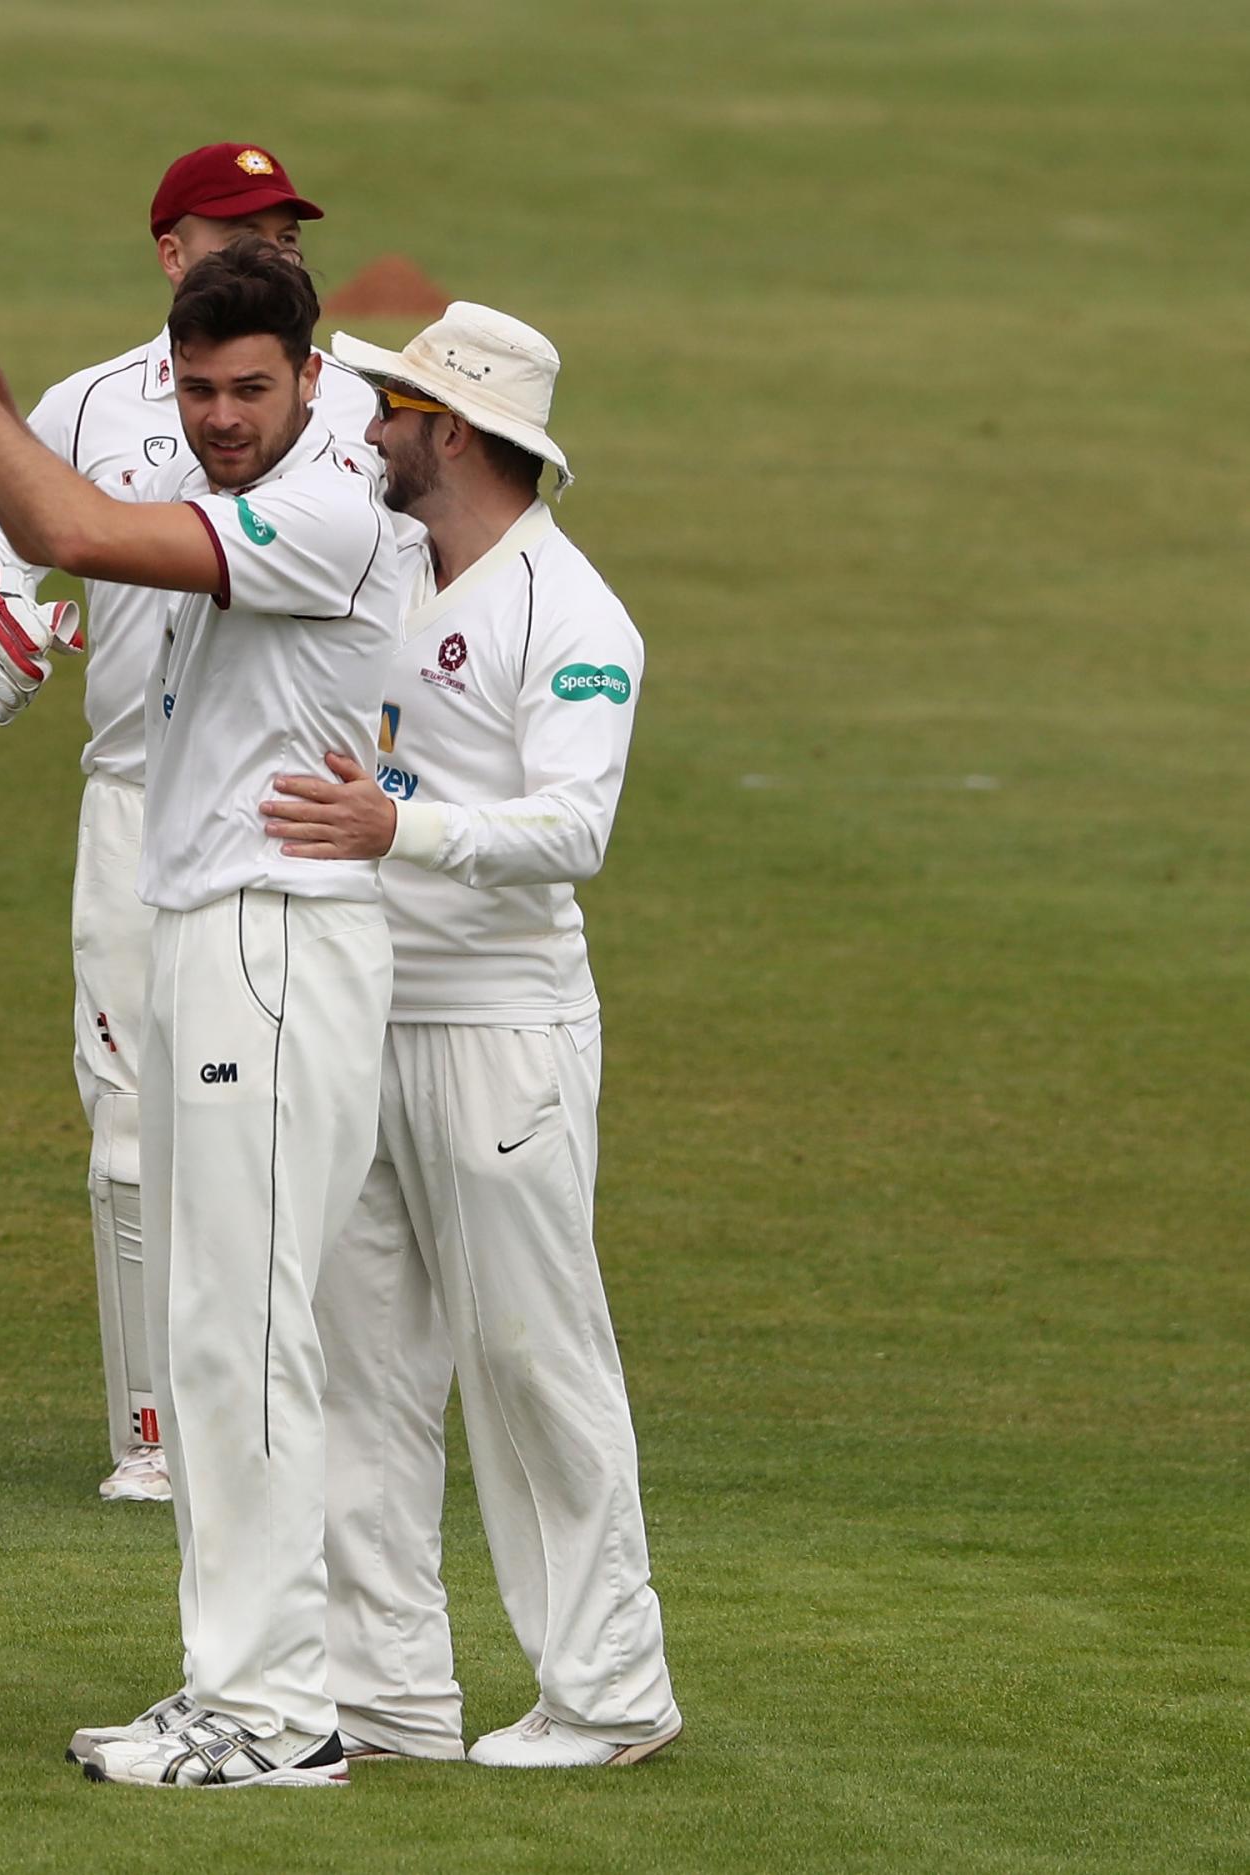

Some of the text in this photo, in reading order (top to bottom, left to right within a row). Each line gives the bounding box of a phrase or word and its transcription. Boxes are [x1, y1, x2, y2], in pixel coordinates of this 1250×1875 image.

[559, 674, 626, 693] Specsavers
[377, 764, 418, 800] vey
[200, 1063, 237, 1083] GM
